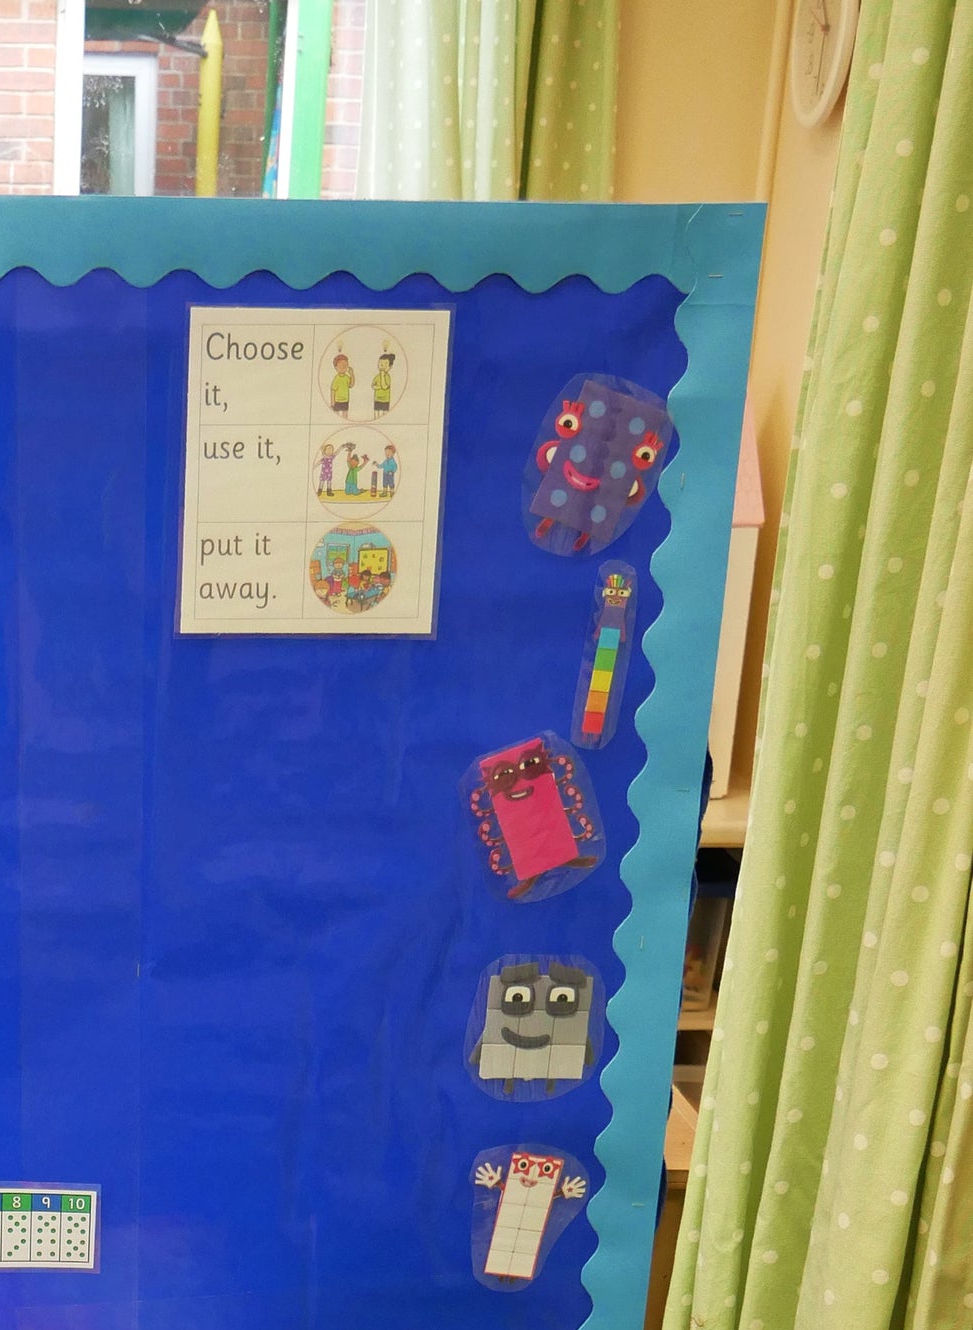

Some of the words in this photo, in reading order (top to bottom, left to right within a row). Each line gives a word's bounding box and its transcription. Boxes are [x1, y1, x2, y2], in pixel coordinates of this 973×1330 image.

[206, 332, 304, 361] Choose
[205, 382, 228, 412] it,
[204, 441, 245, 460] use
[257, 435, 281, 466] it,
[201, 535, 243, 566] put
[255, 532, 271, 556] it
[199, 582, 277, 609] away.
[12, 1196, 21, 1209] 8
[42, 1196, 51, 1209] 9
[68, 1198, 86, 1210] 10
